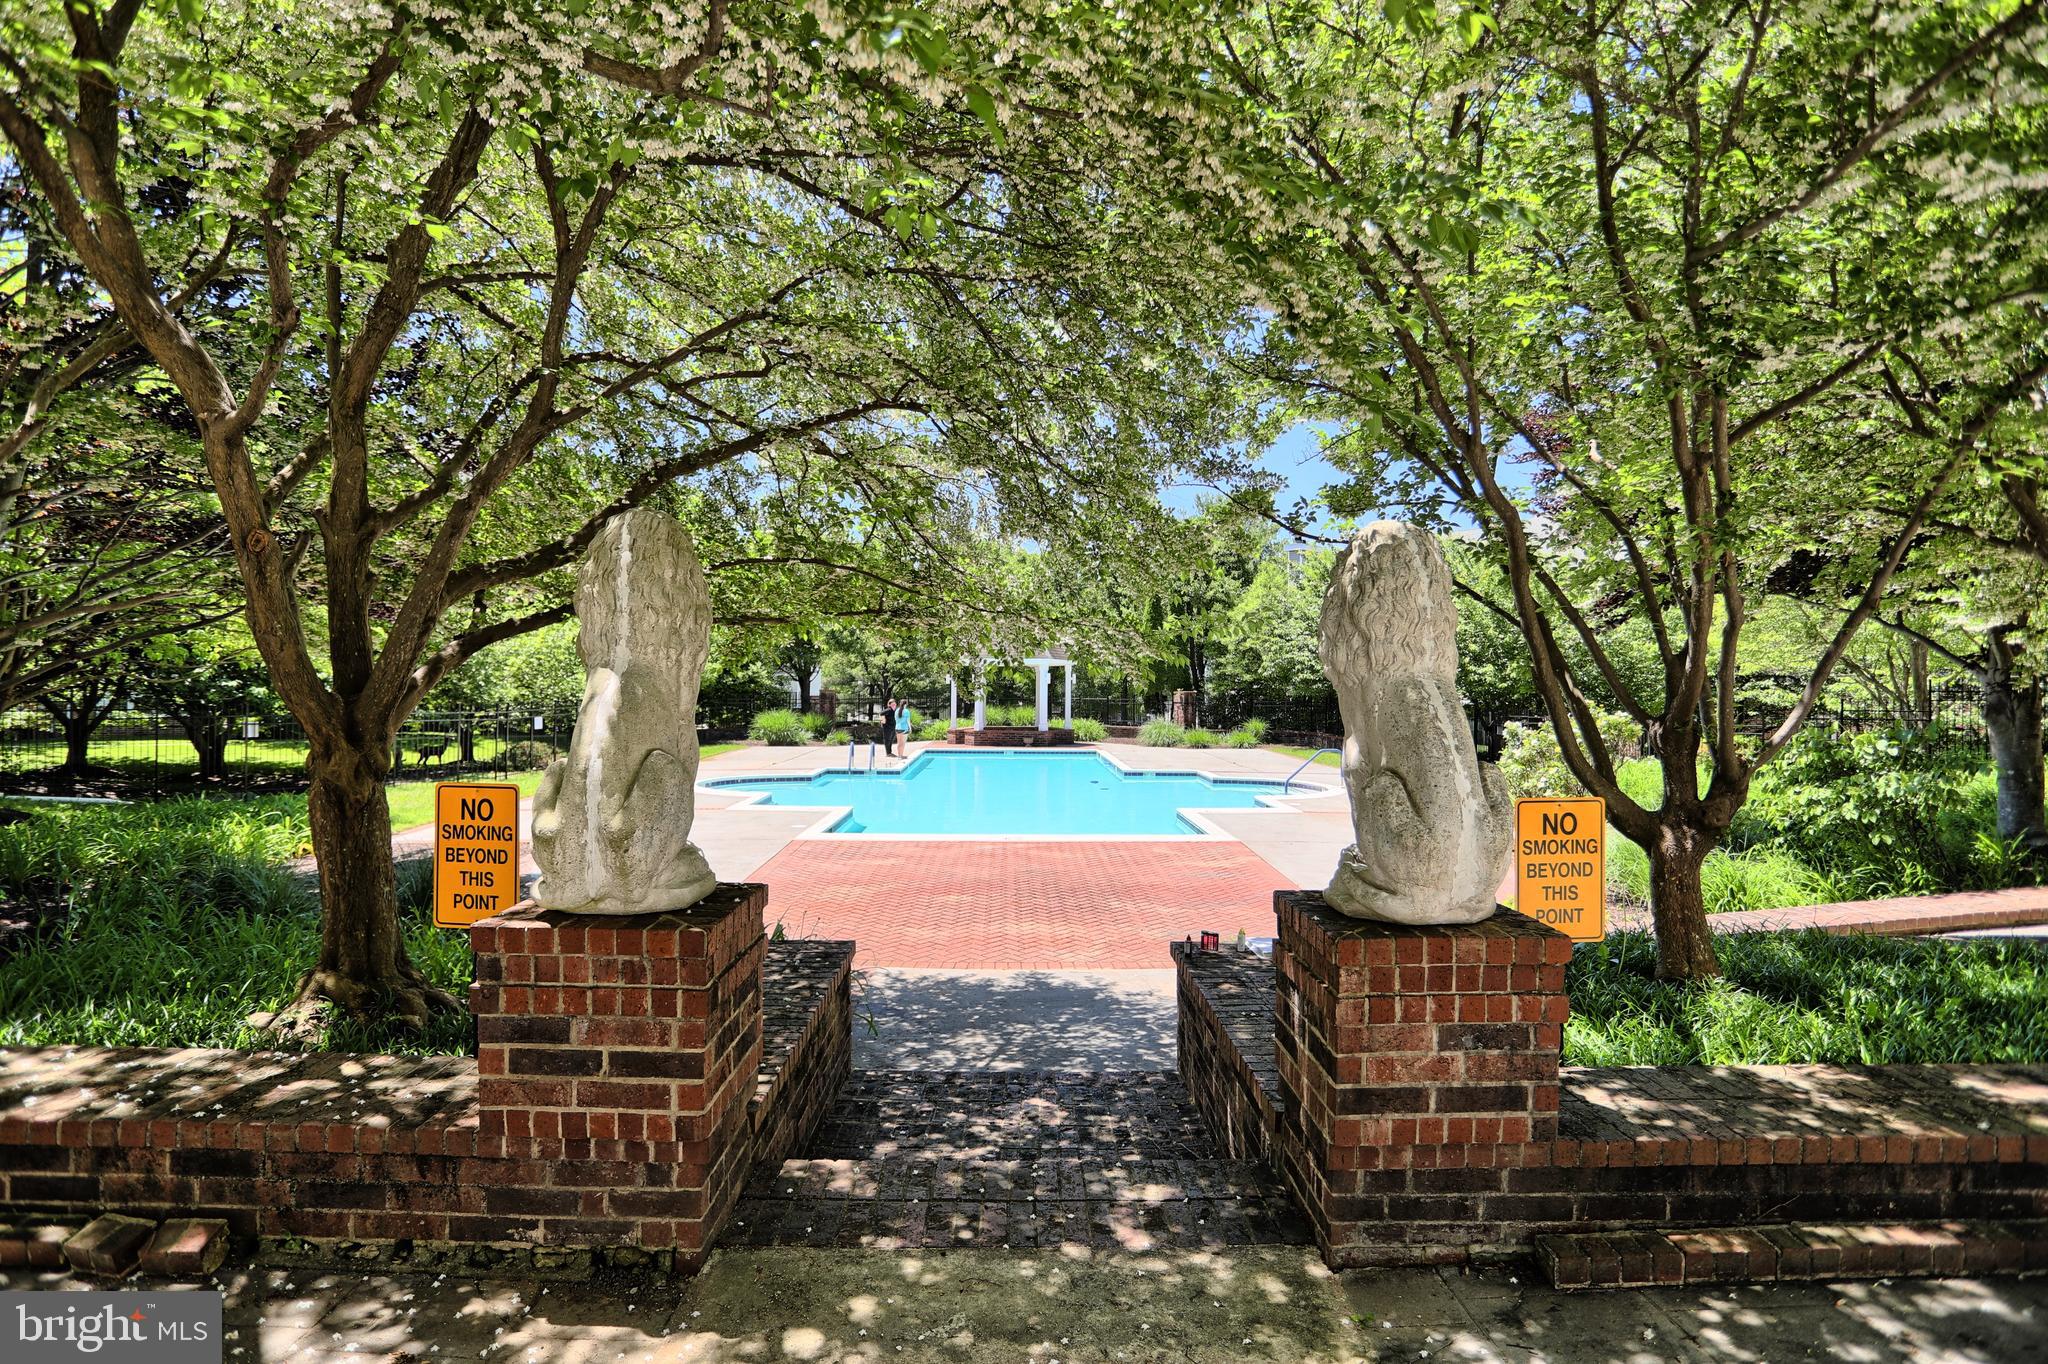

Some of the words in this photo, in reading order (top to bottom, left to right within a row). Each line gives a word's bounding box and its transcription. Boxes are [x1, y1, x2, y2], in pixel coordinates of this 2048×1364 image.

[460, 798, 494, 821] NO
[442, 824, 513, 842] SMOKING
[1542, 812, 1578, 836] NO
[445, 847, 508, 865] BEYOND
[1522, 838, 1598, 856] SMOKING
[459, 870, 494, 888] THIS
[1526, 862, 1593, 879] BEYOND
[1542, 884, 1579, 901] THIS
[453, 893, 499, 911] POINT
[1535, 908, 1584, 924] POINT
